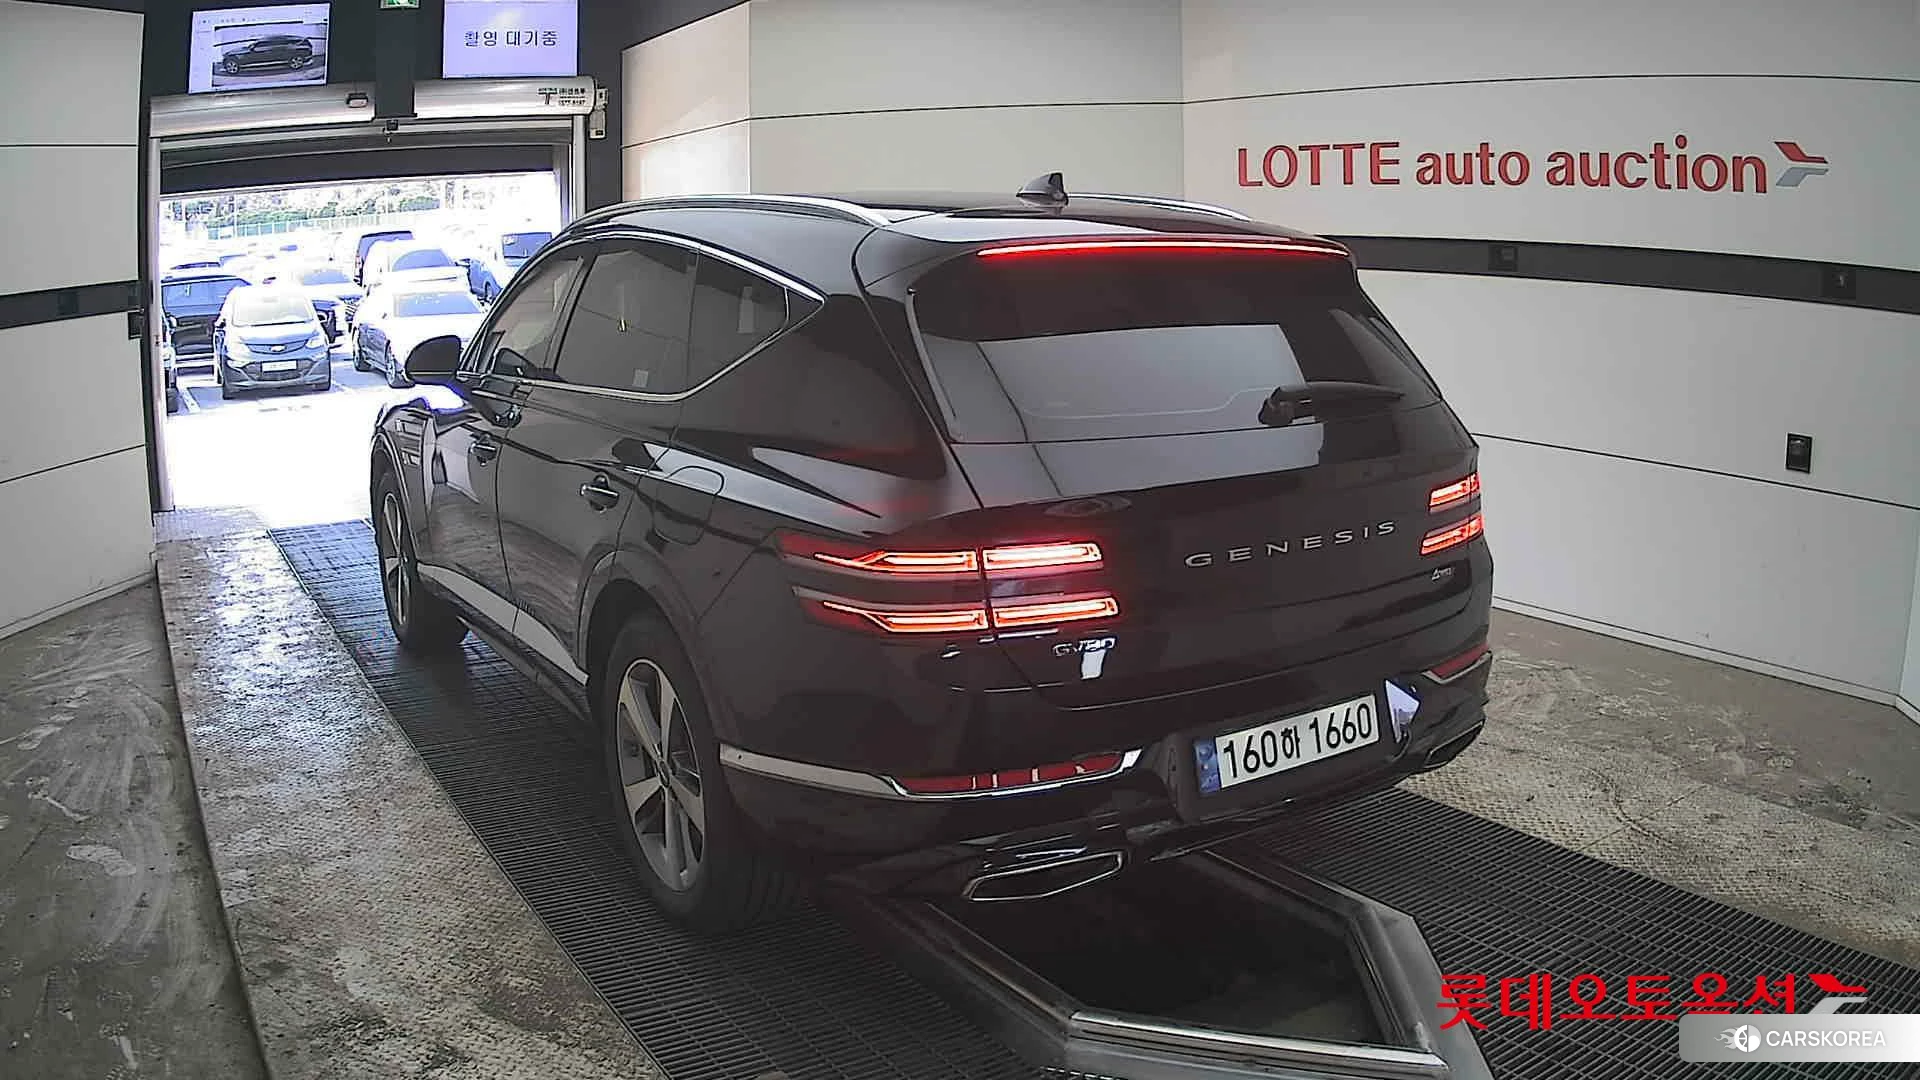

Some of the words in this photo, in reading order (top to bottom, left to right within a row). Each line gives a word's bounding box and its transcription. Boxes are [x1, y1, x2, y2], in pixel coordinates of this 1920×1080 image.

[506, 30, 558, 47] 대기중
[1238, 141, 1400, 188] LOTTE
[1416, 142, 1530, 186] auto
[1546, 134, 1767, 193] auction
[1184, 521, 1395, 567] GENESIS
[1053, 638, 1116, 656] GV80
[1223, 725, 1301, 778] 160하
[1309, 703, 1373, 754] 1660
